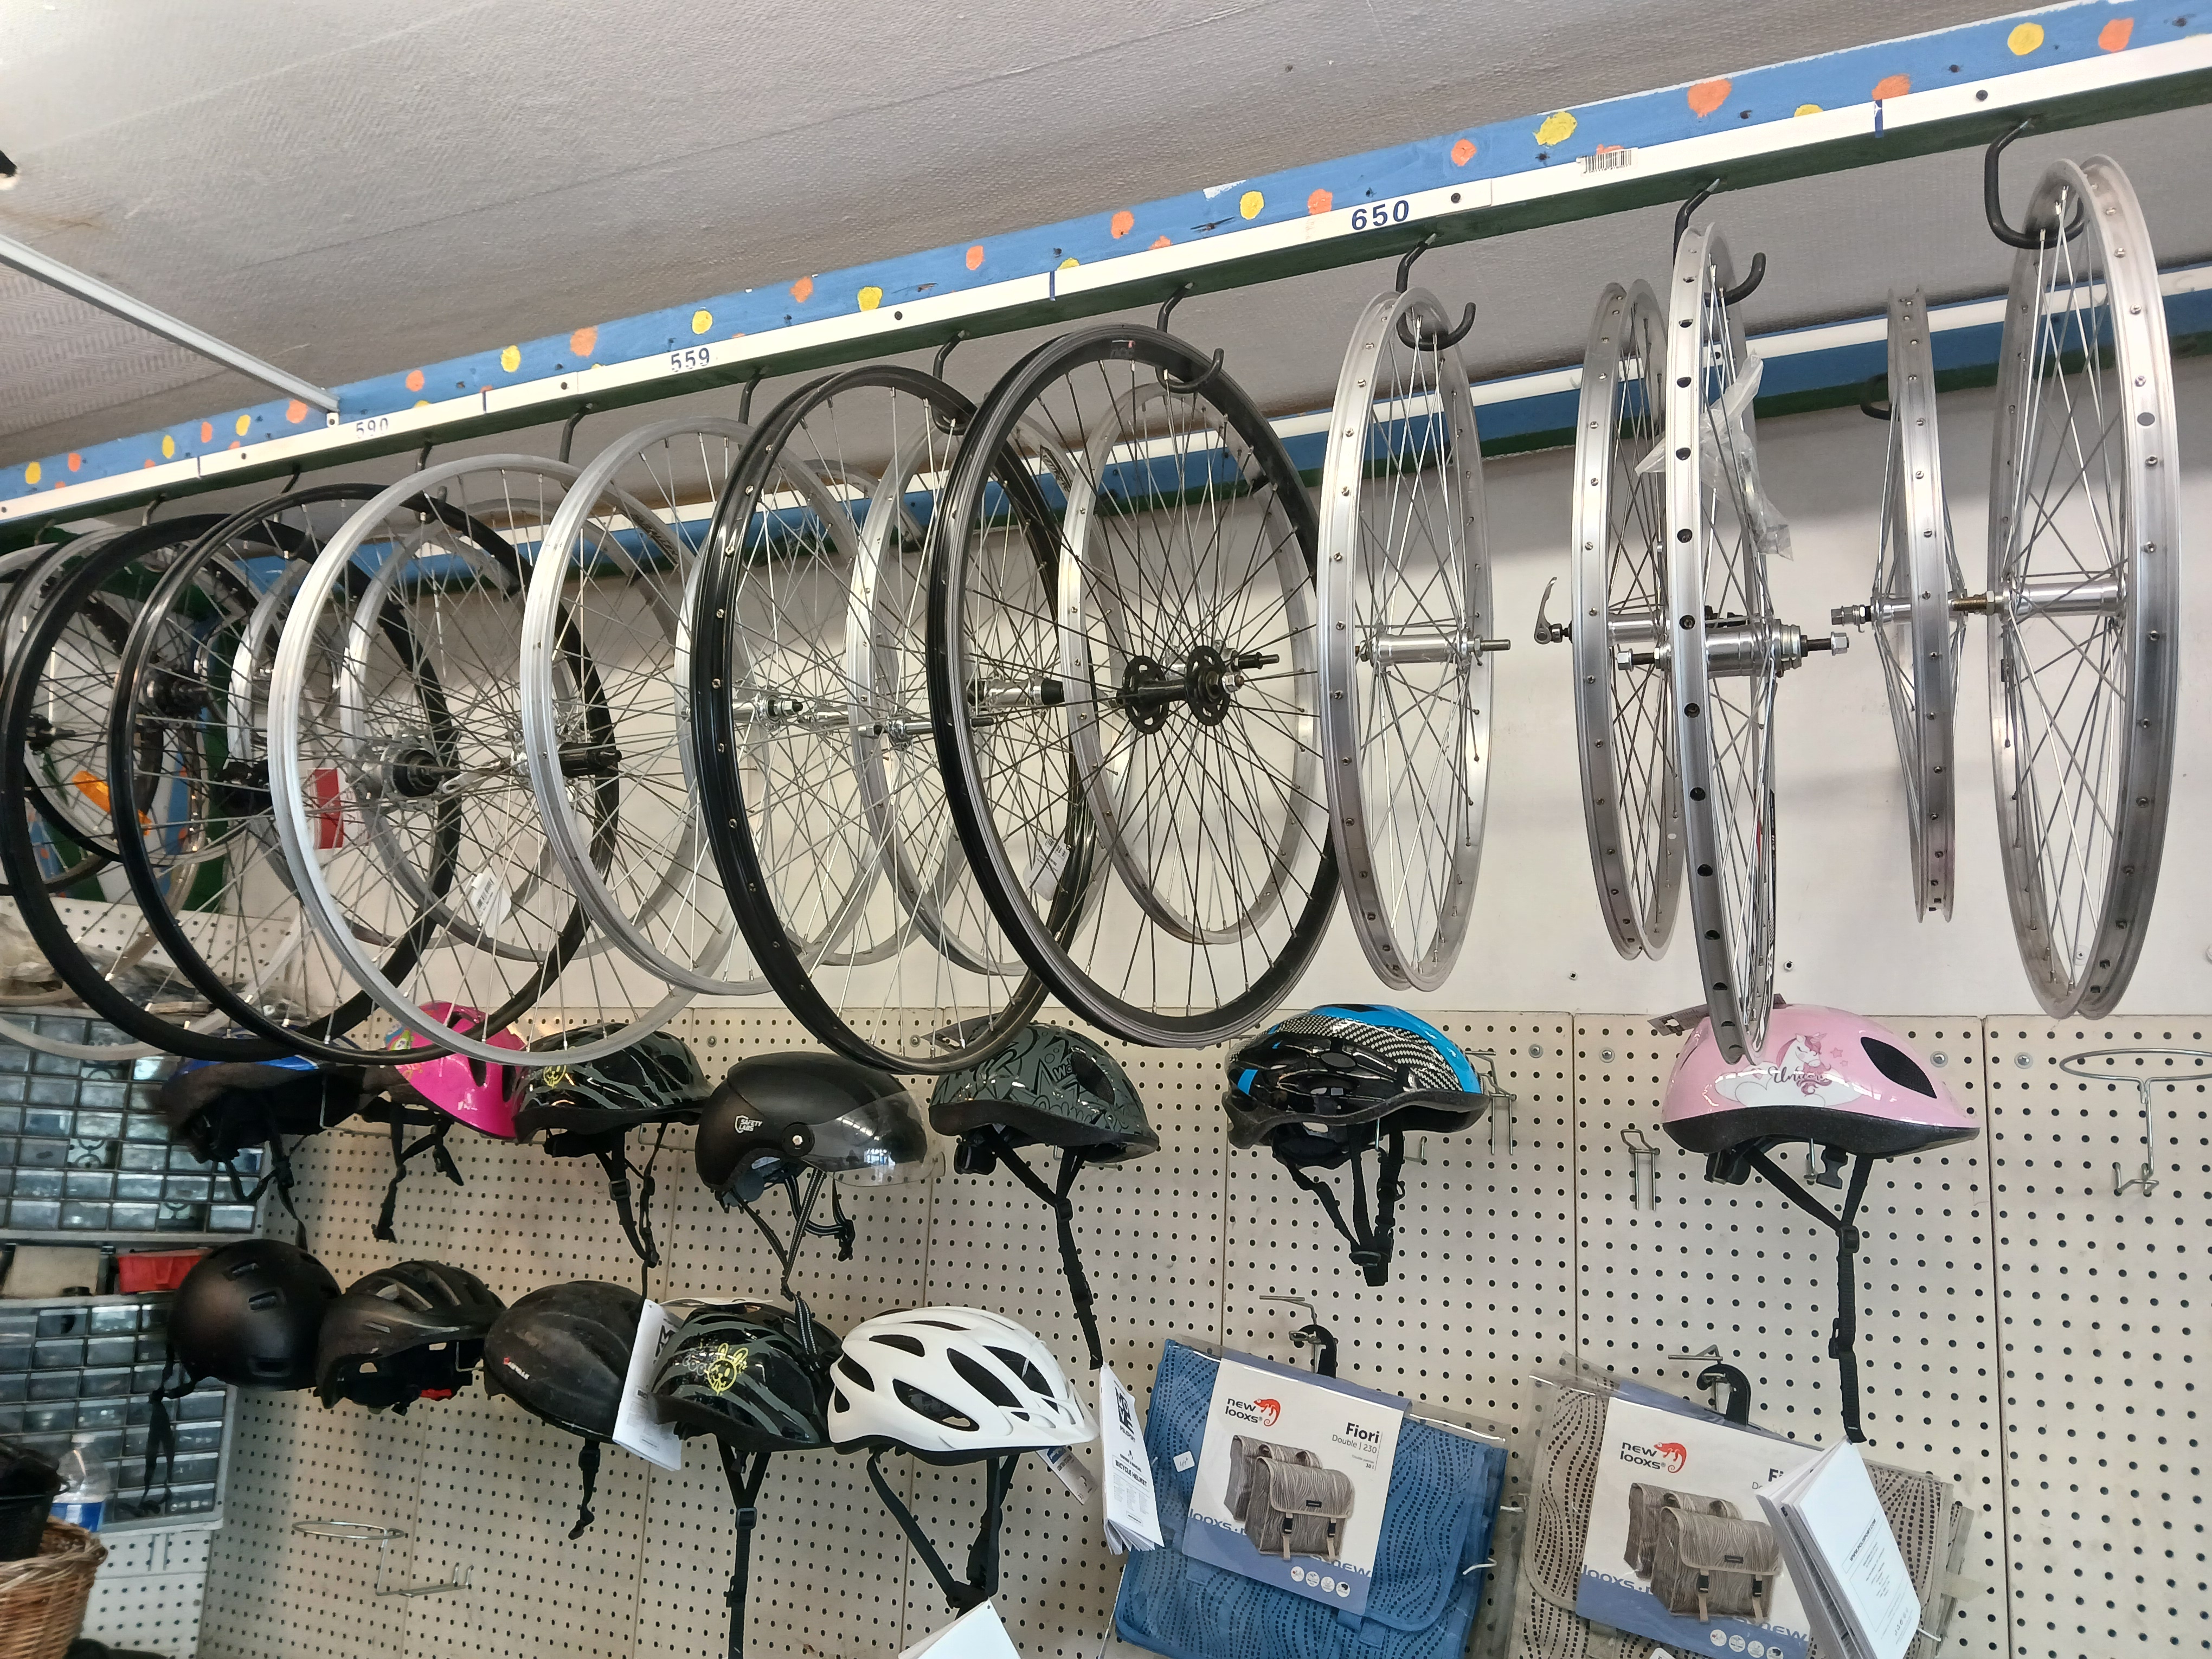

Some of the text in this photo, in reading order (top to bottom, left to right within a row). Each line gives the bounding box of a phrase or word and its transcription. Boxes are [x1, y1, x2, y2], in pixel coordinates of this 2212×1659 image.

[1352, 200, 1409, 230] 650
[671, 348, 710, 372] 559
[356, 417, 388, 439] 590
[740, 1118, 763, 1127] SAFETY
[1227, 1398, 1256, 1412] new
[1332, 1434, 1358, 1449] Double
[1363, 1443, 1378, 1454] 230
[1346, 1422, 1380, 1444] Fiori
[1622, 1442, 1657, 1457] new
[1115, 1459, 1147, 1487] BICYCLE HELMET
[1849, 1518, 1876, 1561] WWW.POLISPORT.COM
